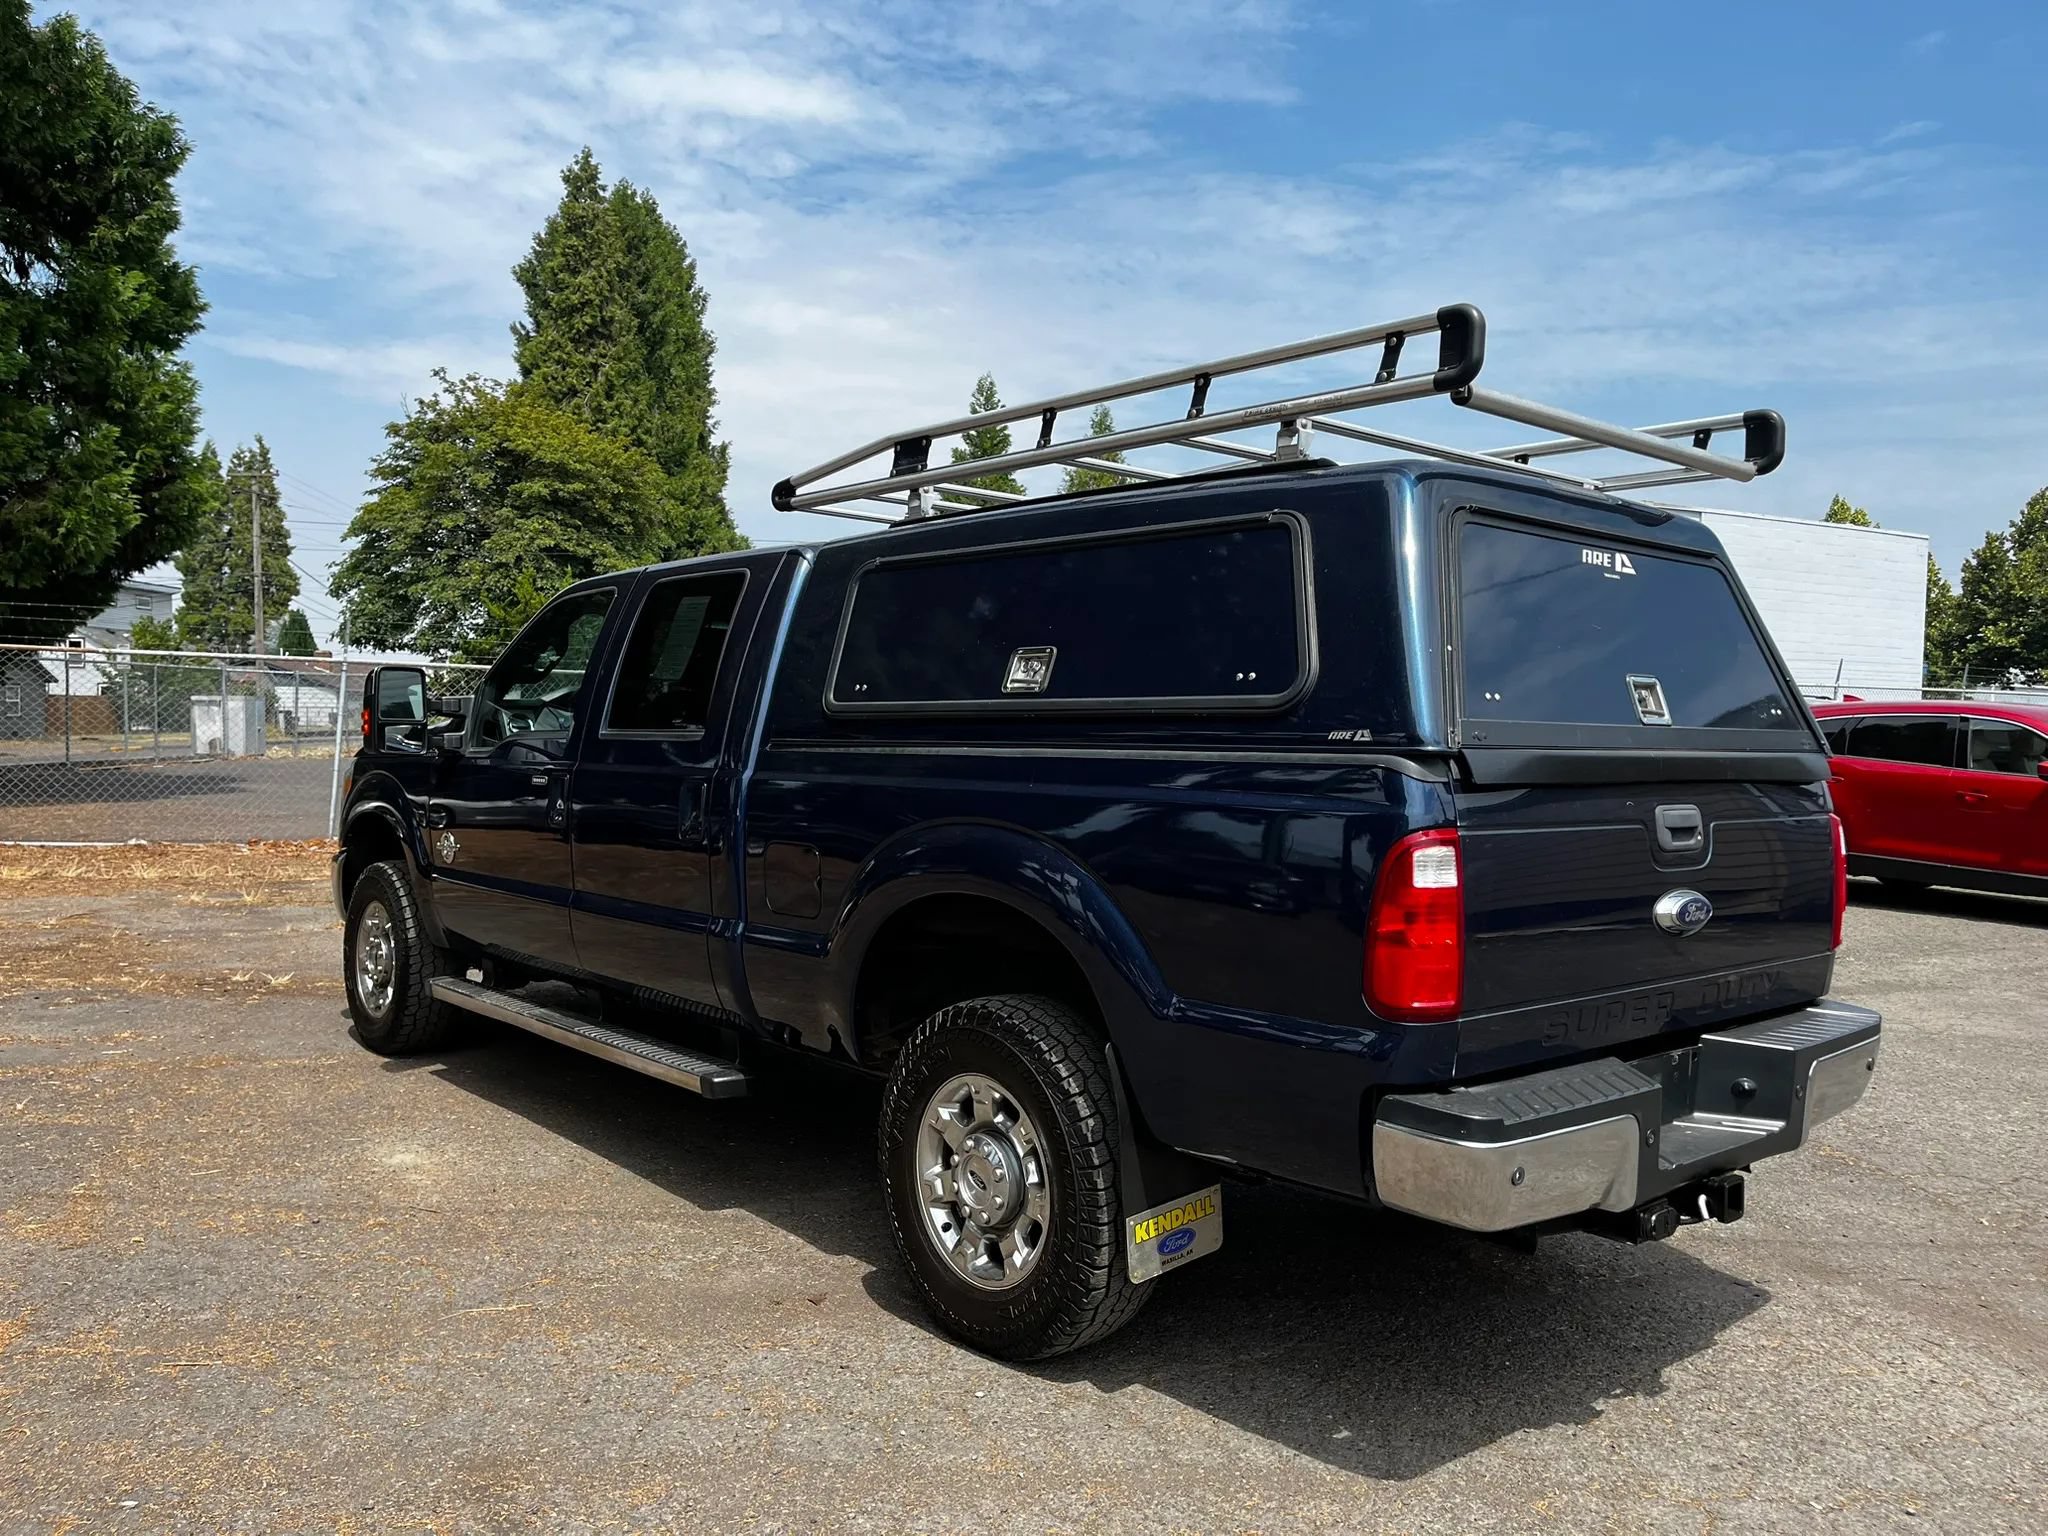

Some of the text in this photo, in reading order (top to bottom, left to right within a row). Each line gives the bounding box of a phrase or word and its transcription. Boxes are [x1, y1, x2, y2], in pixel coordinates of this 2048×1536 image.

[1582, 549, 1612, 567] ARE
[1328, 731, 1354, 740] ARE
[1685, 903, 1707, 921] Ford
[1541, 970, 1780, 1046] SUPER DUTY
[1134, 1195, 1215, 1245] KENDALL
[1164, 1233, 1190, 1252] Ford
